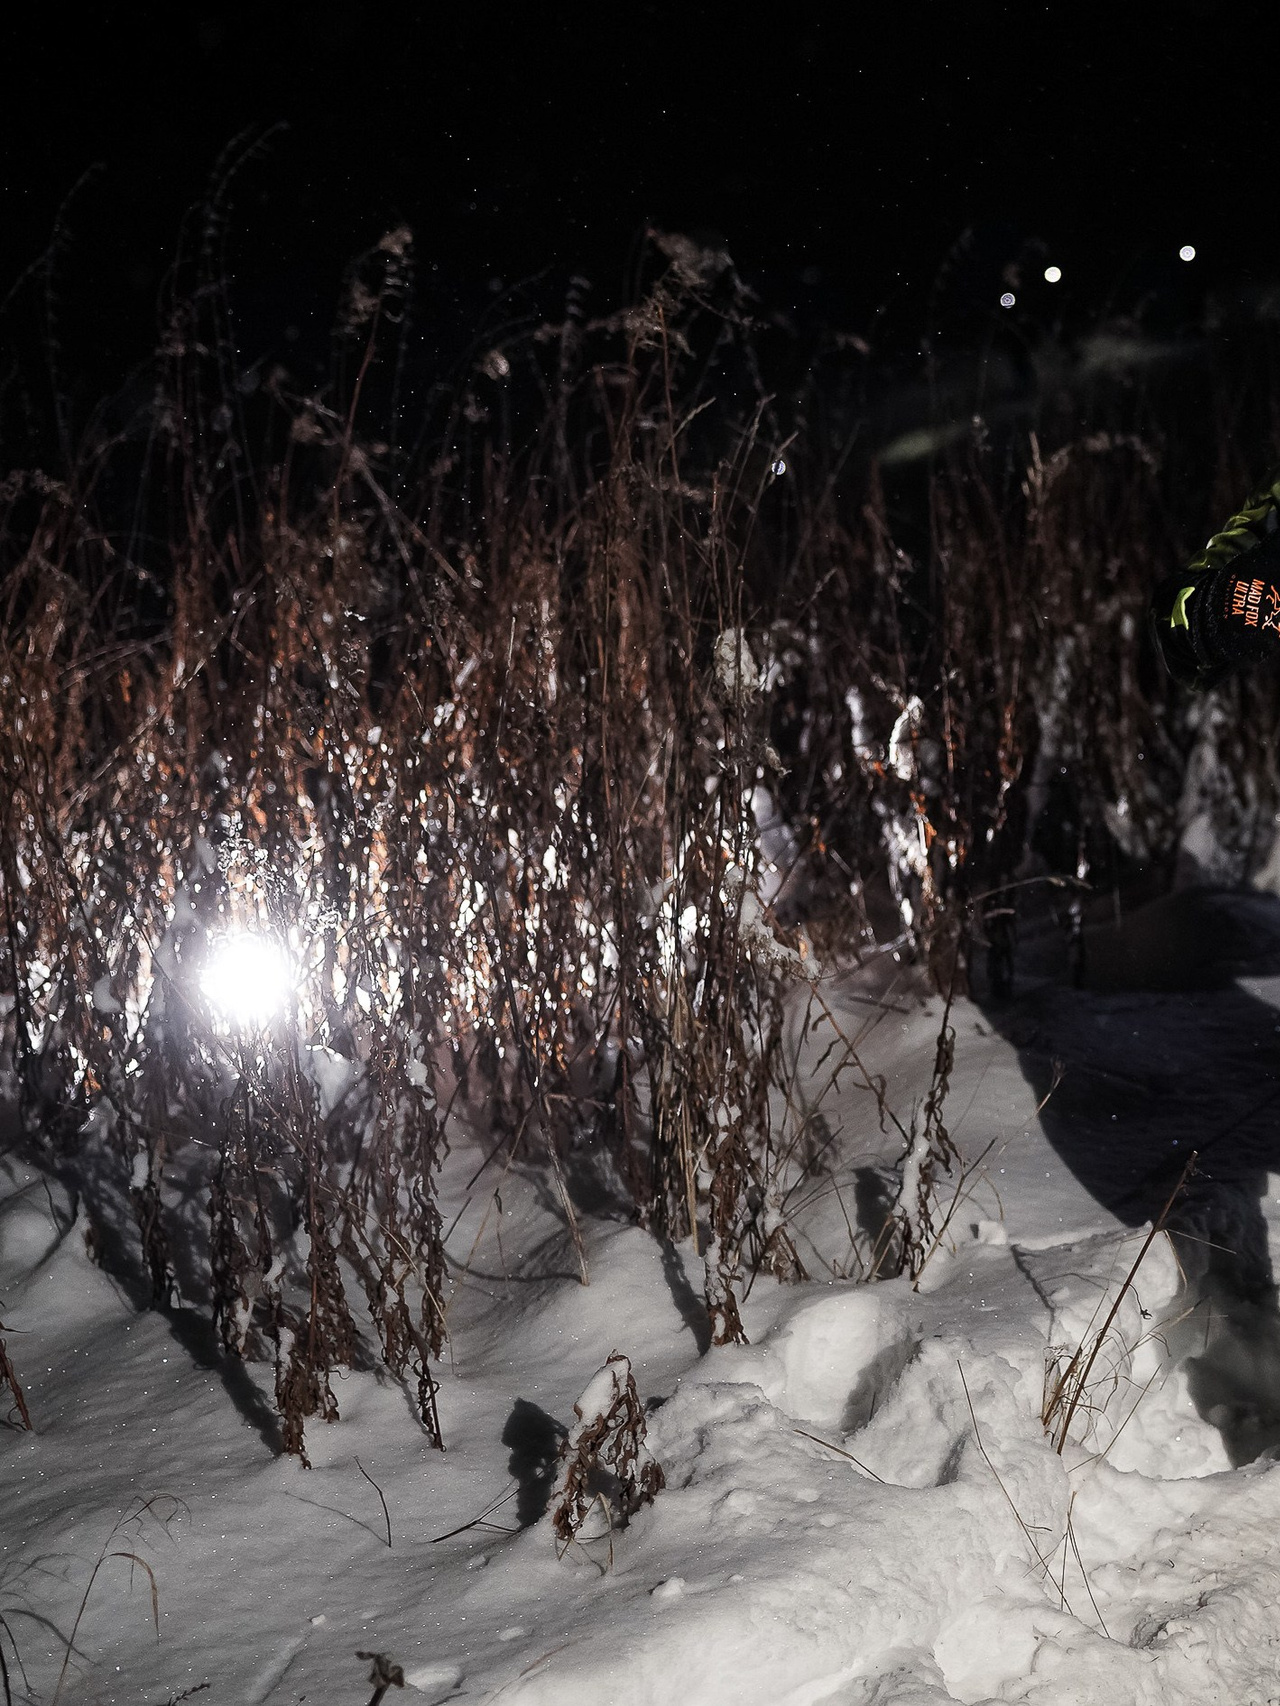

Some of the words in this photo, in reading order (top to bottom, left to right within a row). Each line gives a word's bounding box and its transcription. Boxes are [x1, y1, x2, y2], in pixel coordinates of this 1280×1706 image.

[1231, 580, 1250, 615] ULTRA
[1247, 578, 1265, 604] MAD
[1244, 605, 1260, 627] FOX
